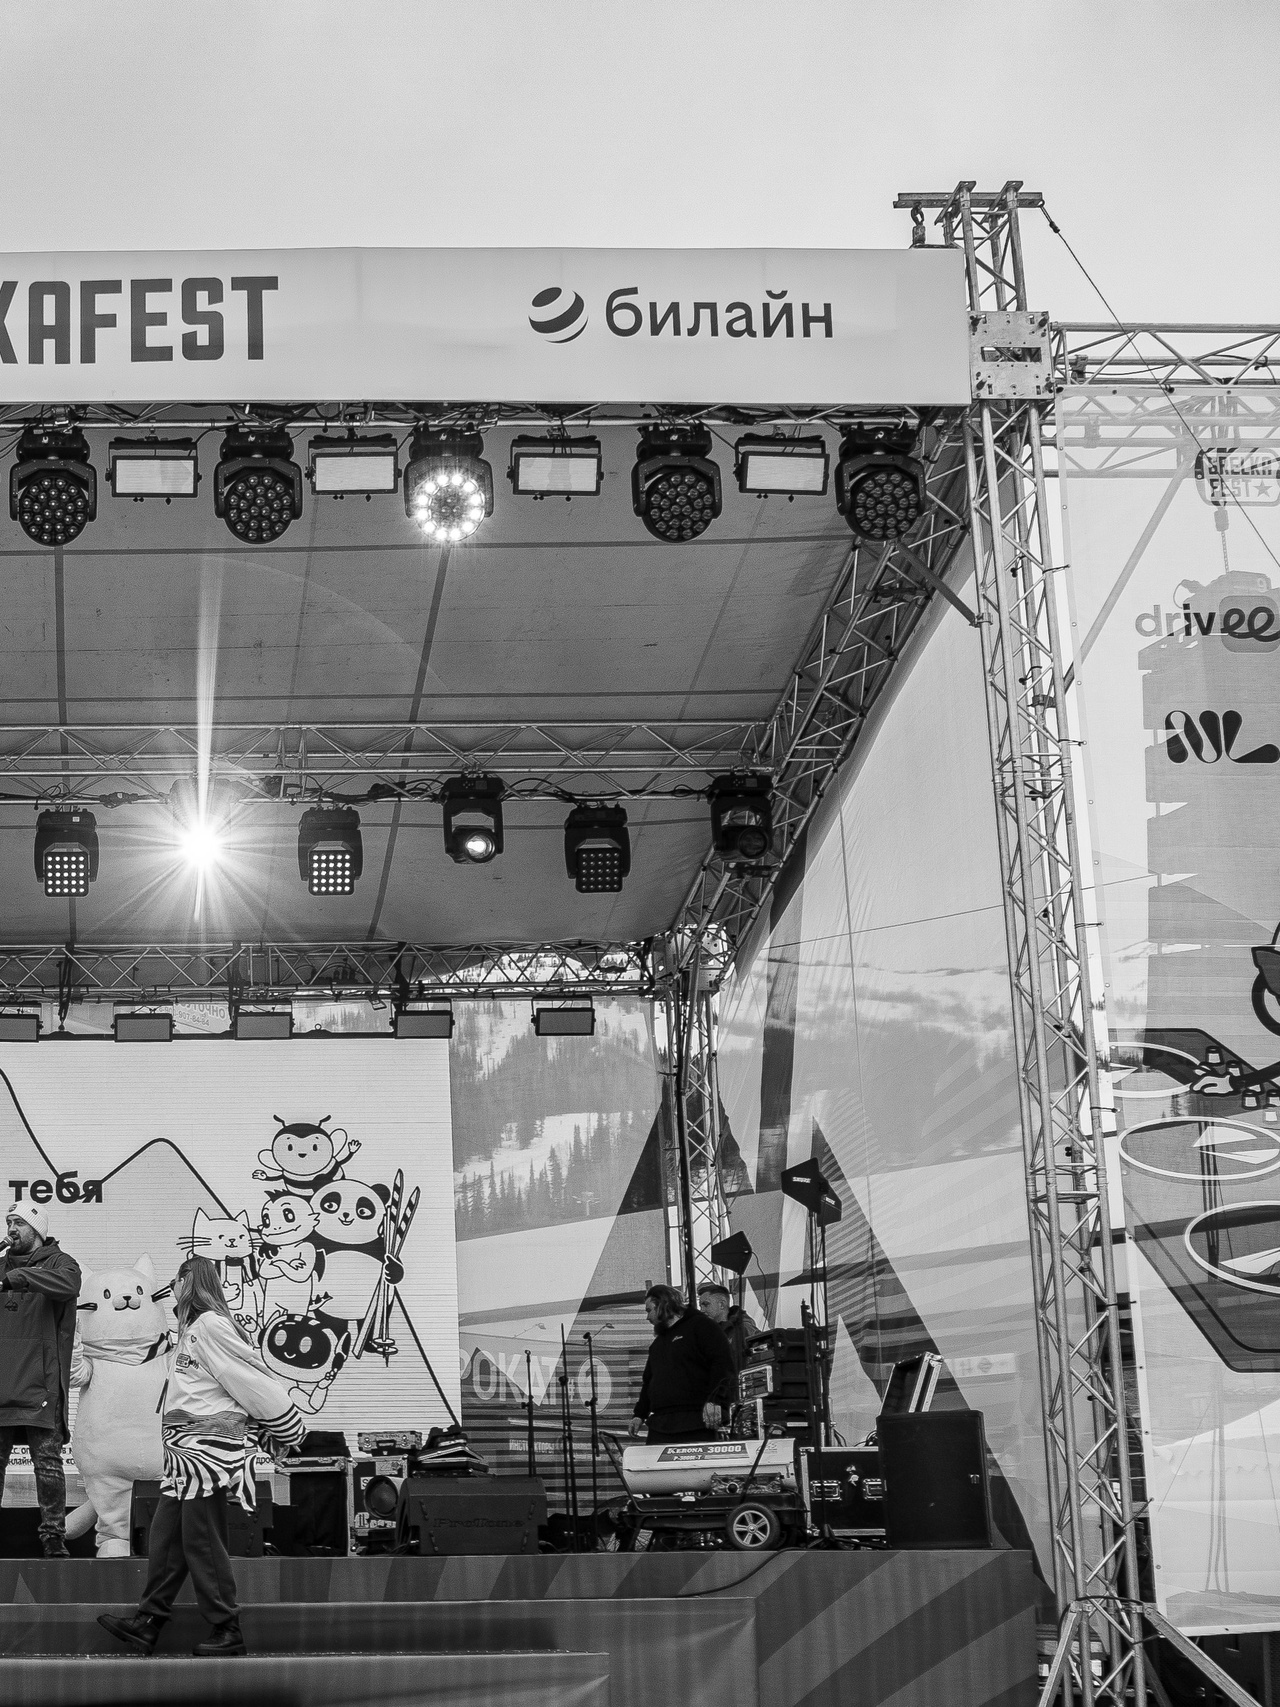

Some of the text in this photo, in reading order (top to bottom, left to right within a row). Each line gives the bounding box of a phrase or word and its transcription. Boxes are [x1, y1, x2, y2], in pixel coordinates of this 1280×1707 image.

[605, 286, 834, 339] билайн
[1208, 456, 1272, 476] GRELKA
[1135, 603, 1280, 643] drivee
[8, 1171, 104, 1205] тебя
[707, 1445, 742, 1454] 30000
